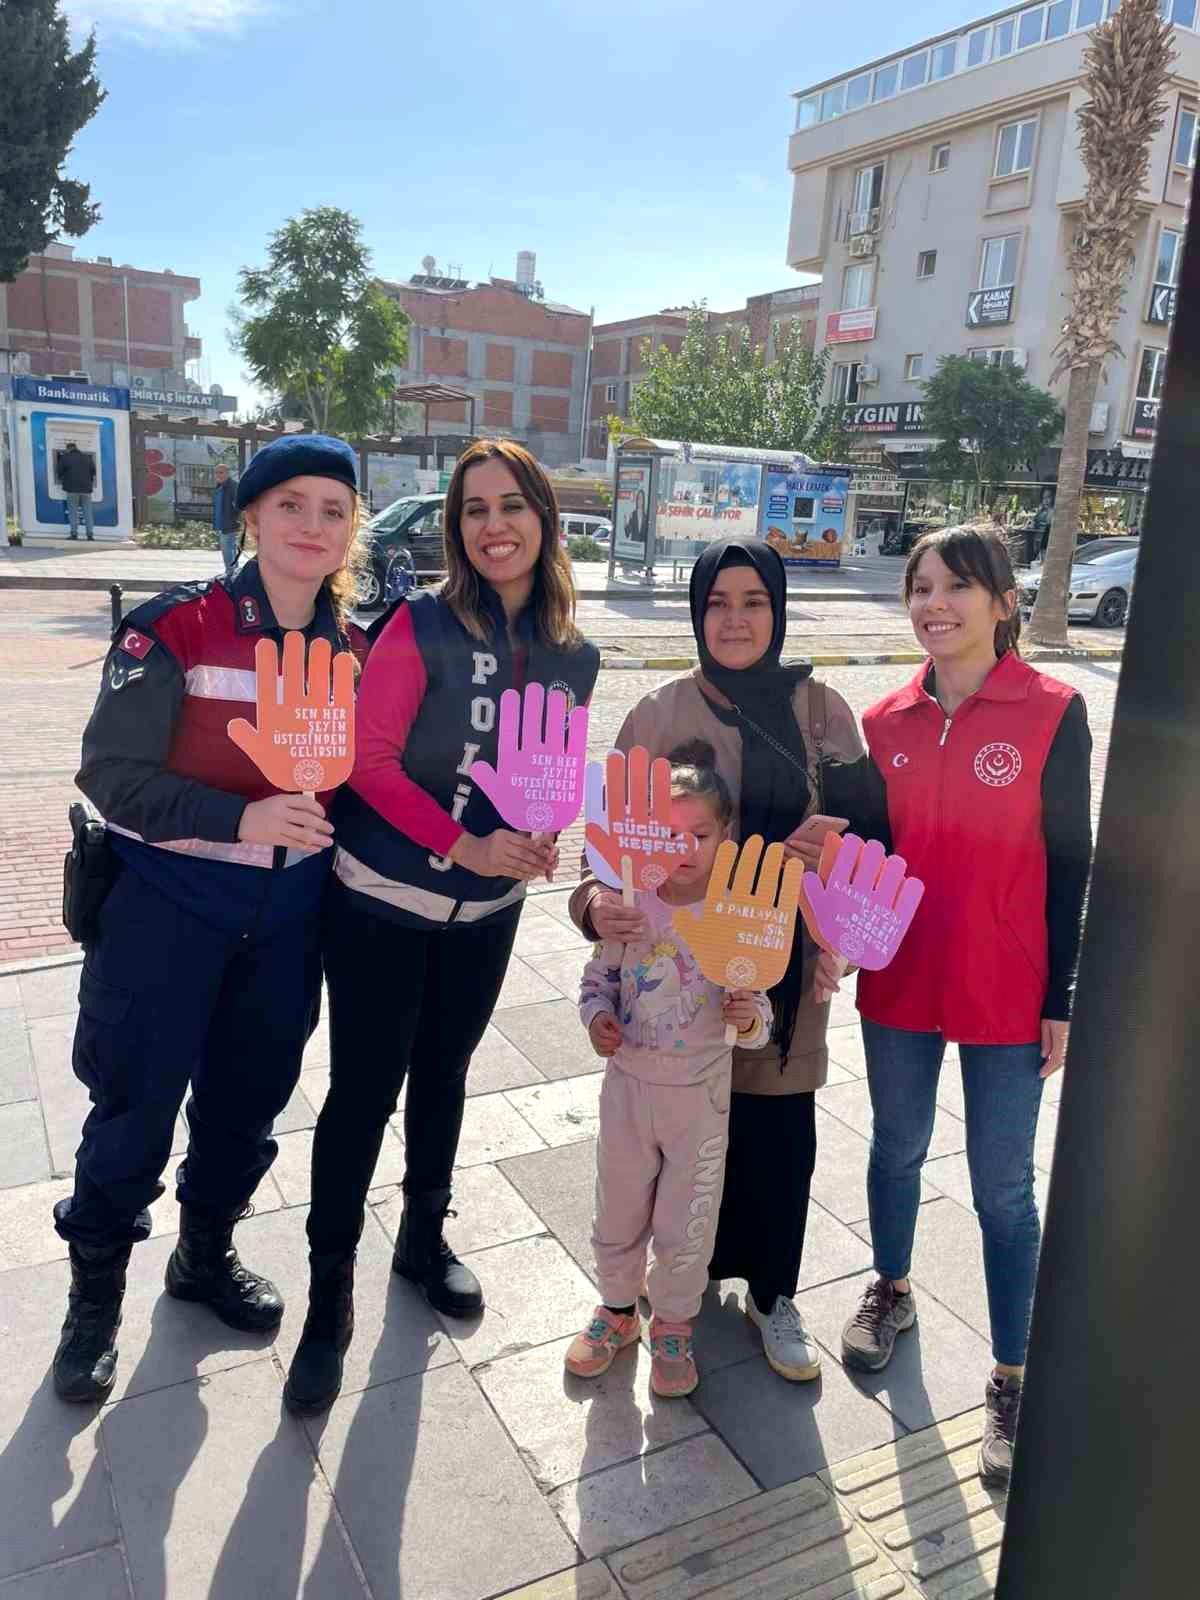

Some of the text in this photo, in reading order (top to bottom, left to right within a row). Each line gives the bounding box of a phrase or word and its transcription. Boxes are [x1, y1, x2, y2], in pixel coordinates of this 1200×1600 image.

[38, 386, 110, 403] Bankamatik
[295, 708, 347, 719] SEN HER
[531, 754, 551, 766] SEN
[612, 818, 685, 840] GÜCÜN
[619, 836, 689, 856] KEŞFET
